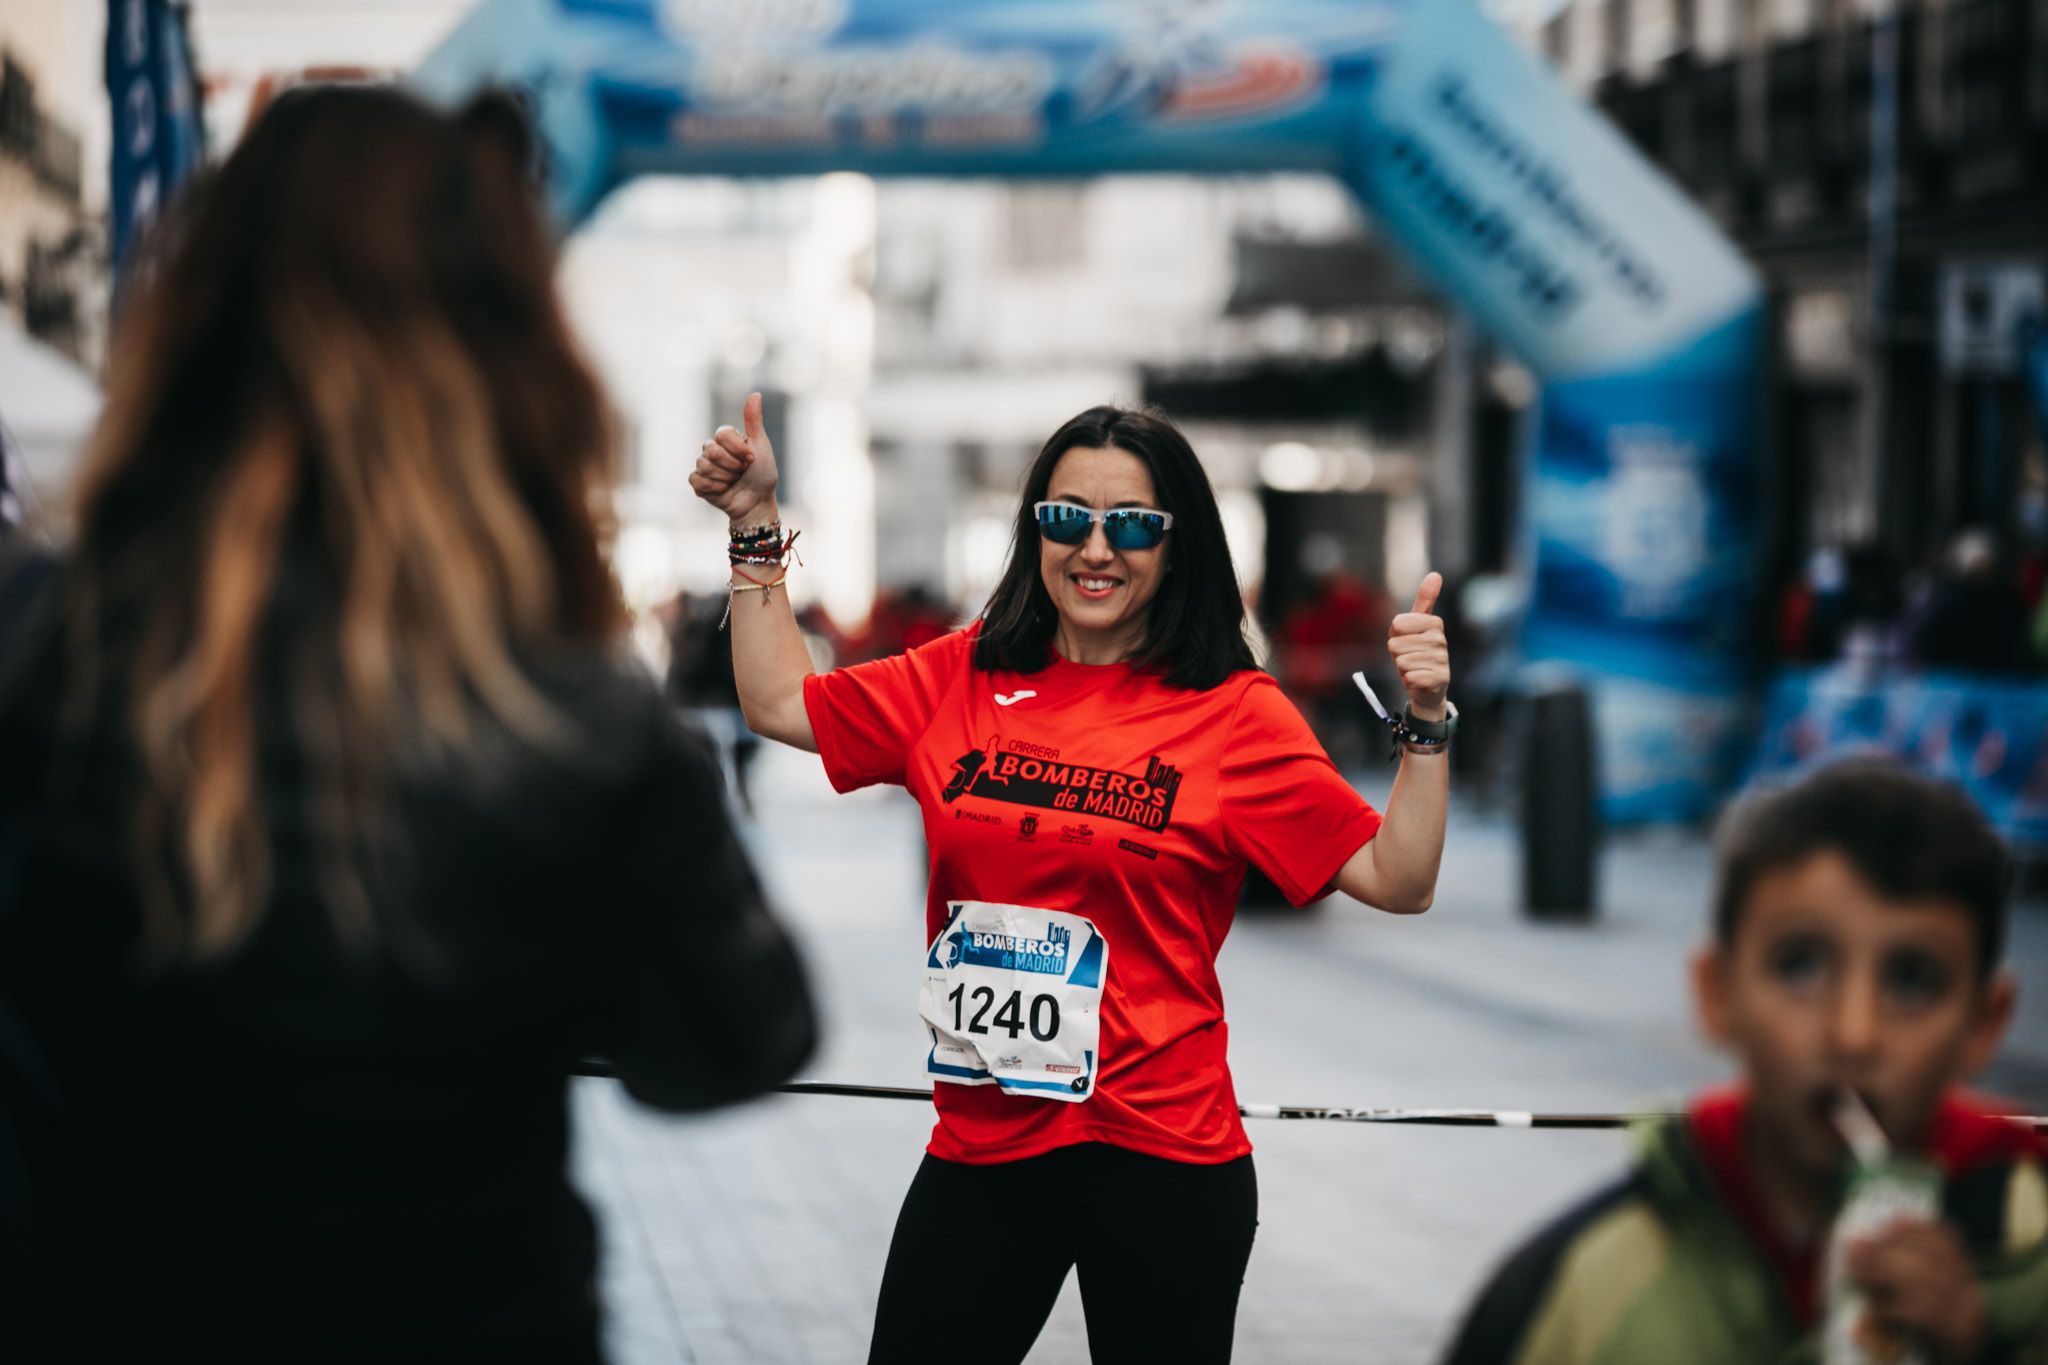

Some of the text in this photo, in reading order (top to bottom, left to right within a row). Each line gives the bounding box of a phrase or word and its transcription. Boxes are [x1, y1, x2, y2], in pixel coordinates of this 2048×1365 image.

[1008, 739, 1060, 760] CARRERA
[1000, 755, 1168, 807] BOMBEROS
[965, 812, 1002, 825] MADRID
[1054, 788, 1163, 828] de MADRID
[973, 933, 1065, 958] BOMBEROS
[1002, 952, 1064, 973] de MADRID
[949, 983, 1060, 1042] 1240
